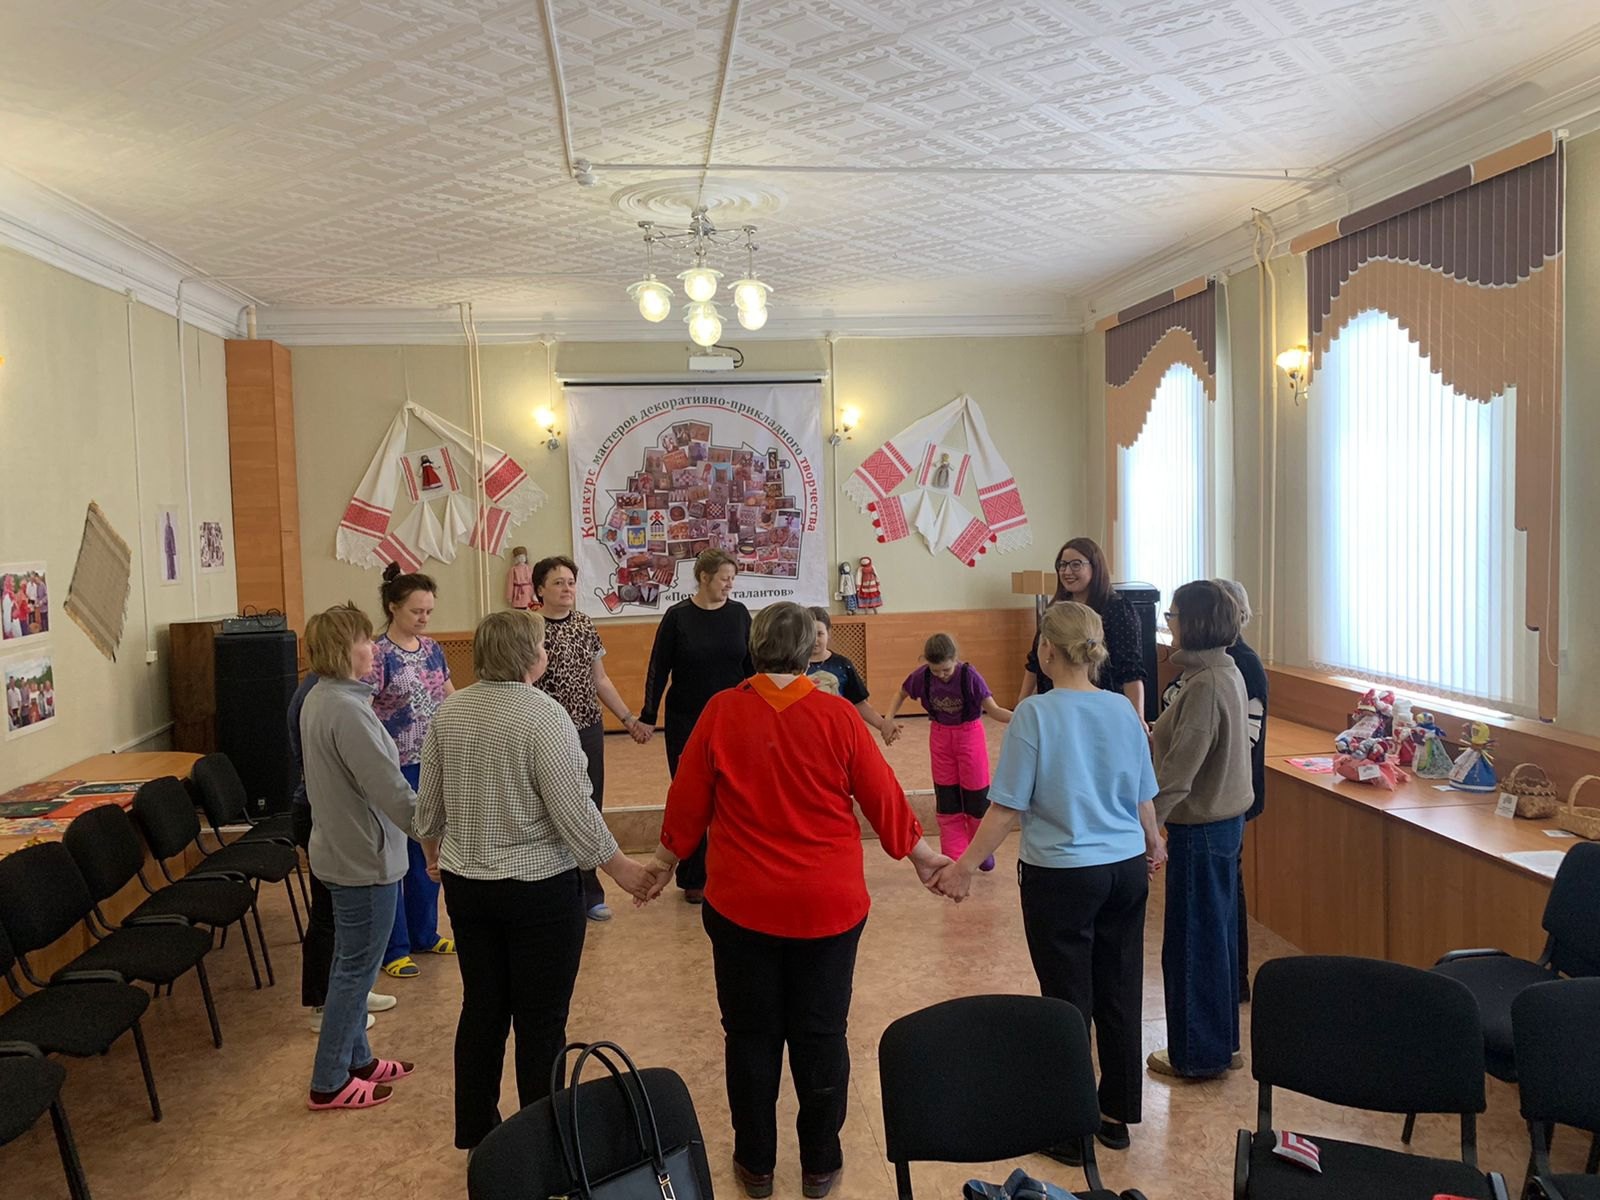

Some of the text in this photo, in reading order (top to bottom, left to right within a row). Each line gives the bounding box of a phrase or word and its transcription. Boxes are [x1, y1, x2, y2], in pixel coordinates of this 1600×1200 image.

[582, 396, 818, 539] Конкурс мастеров декоративно-прикладного творчества
[732, 588, 794, 599] талантов»
